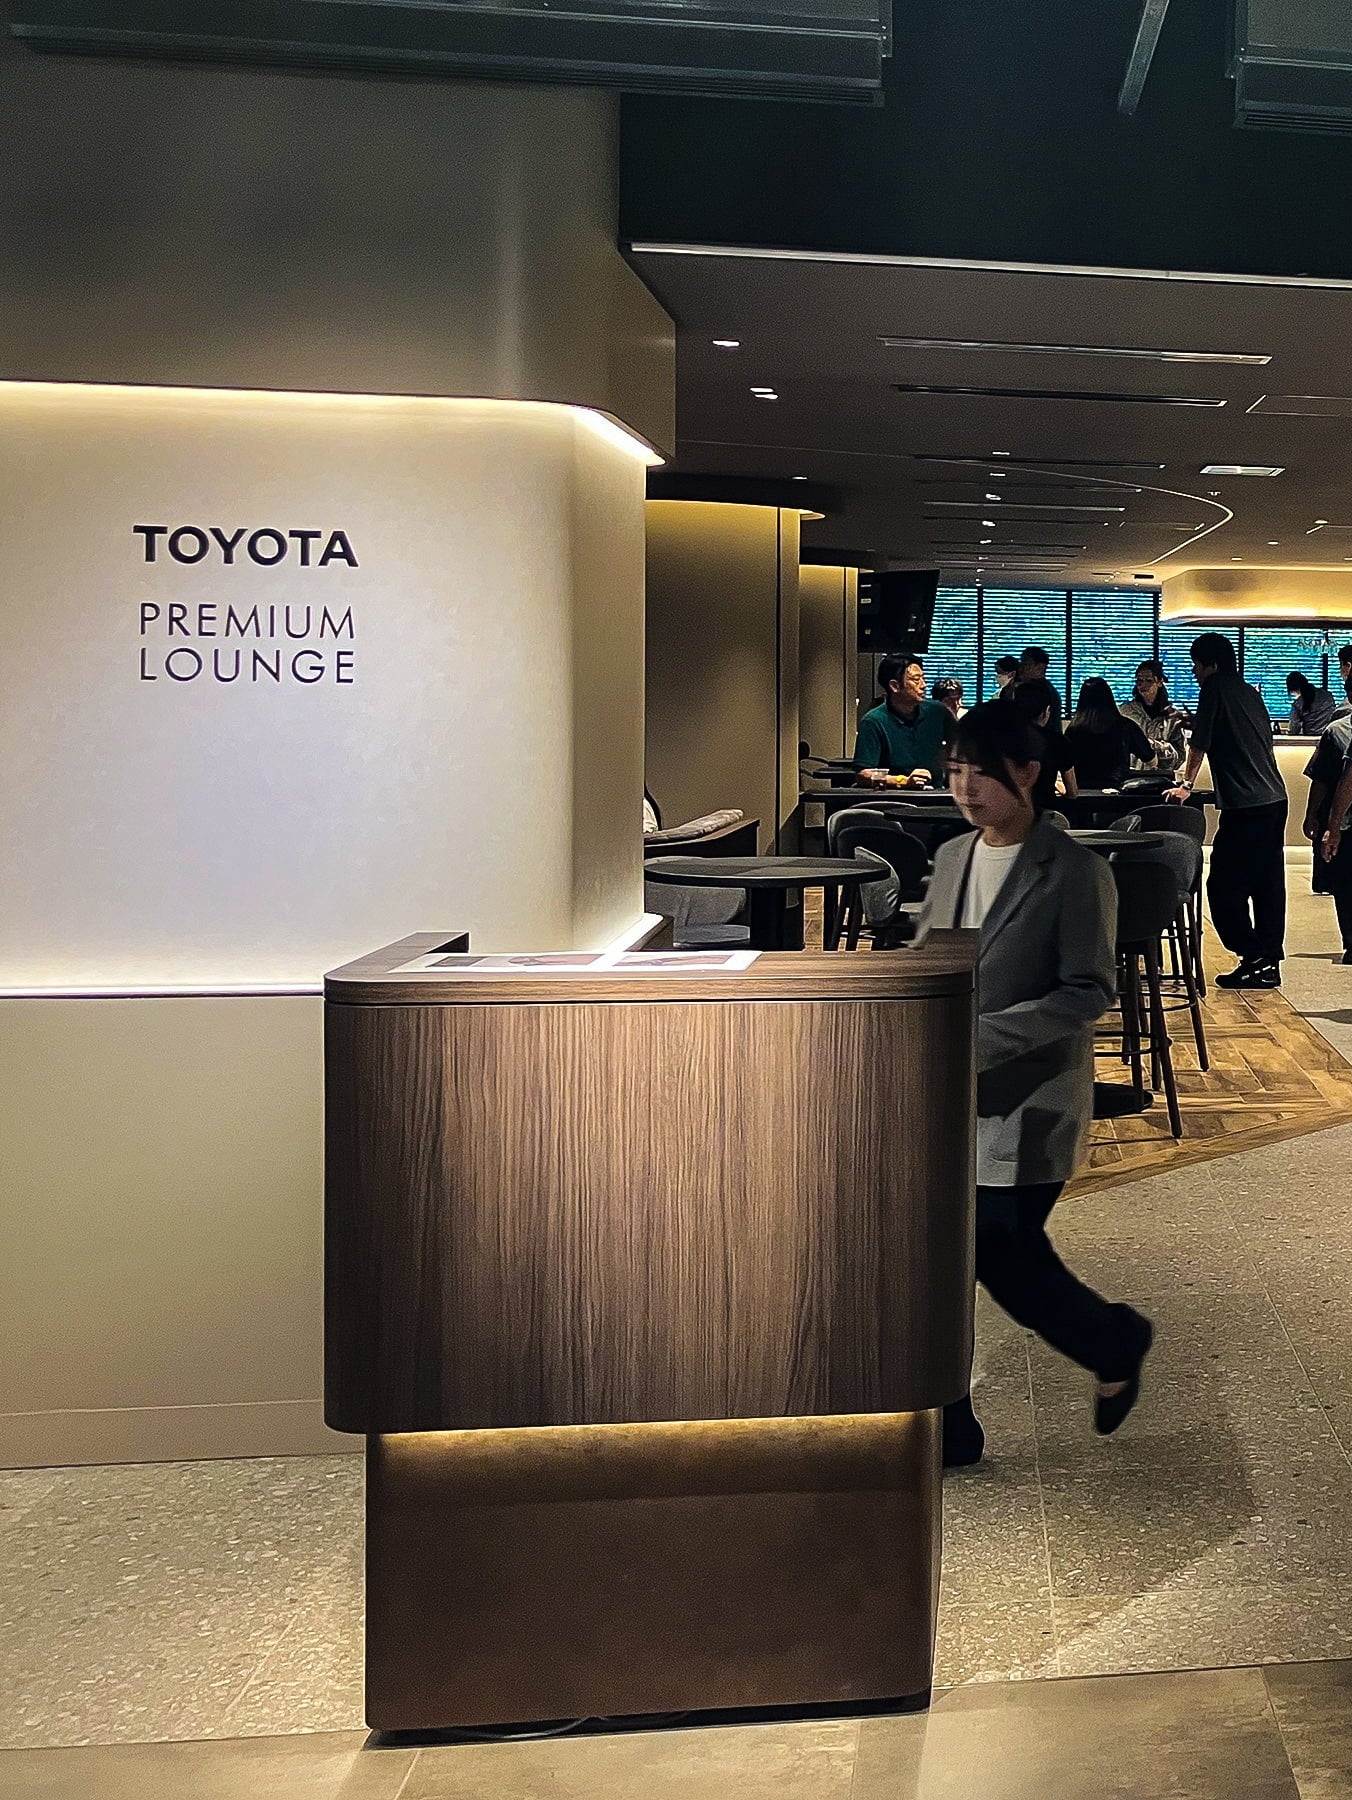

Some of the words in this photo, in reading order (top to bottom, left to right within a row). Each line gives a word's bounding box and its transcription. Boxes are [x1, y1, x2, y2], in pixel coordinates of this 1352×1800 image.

[133, 525, 359, 567] TOYOTA
[140, 602, 354, 639] PREMIUM
[140, 647, 354, 683] LOUNGE
